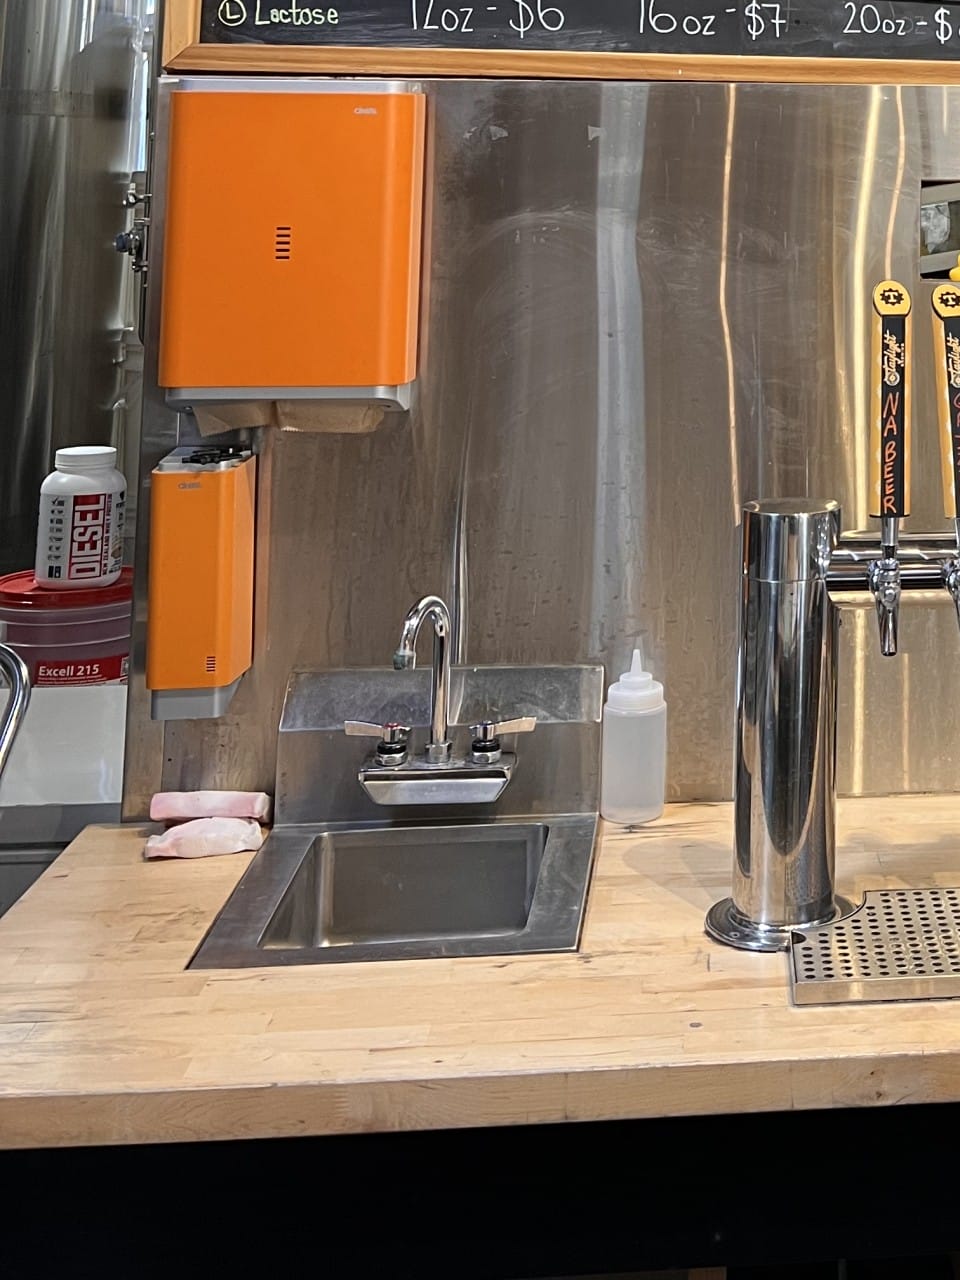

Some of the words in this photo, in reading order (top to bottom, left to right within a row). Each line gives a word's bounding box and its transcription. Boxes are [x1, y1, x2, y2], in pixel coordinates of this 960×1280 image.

[744, 0, 787, 41] $7
[883, 392, 899, 437] NA
[883, 441, 896, 513] BEER
[69, 495, 104, 578] DIESEL
[39, 666, 74, 677] Excell
[76, 664, 100, 676] 215
